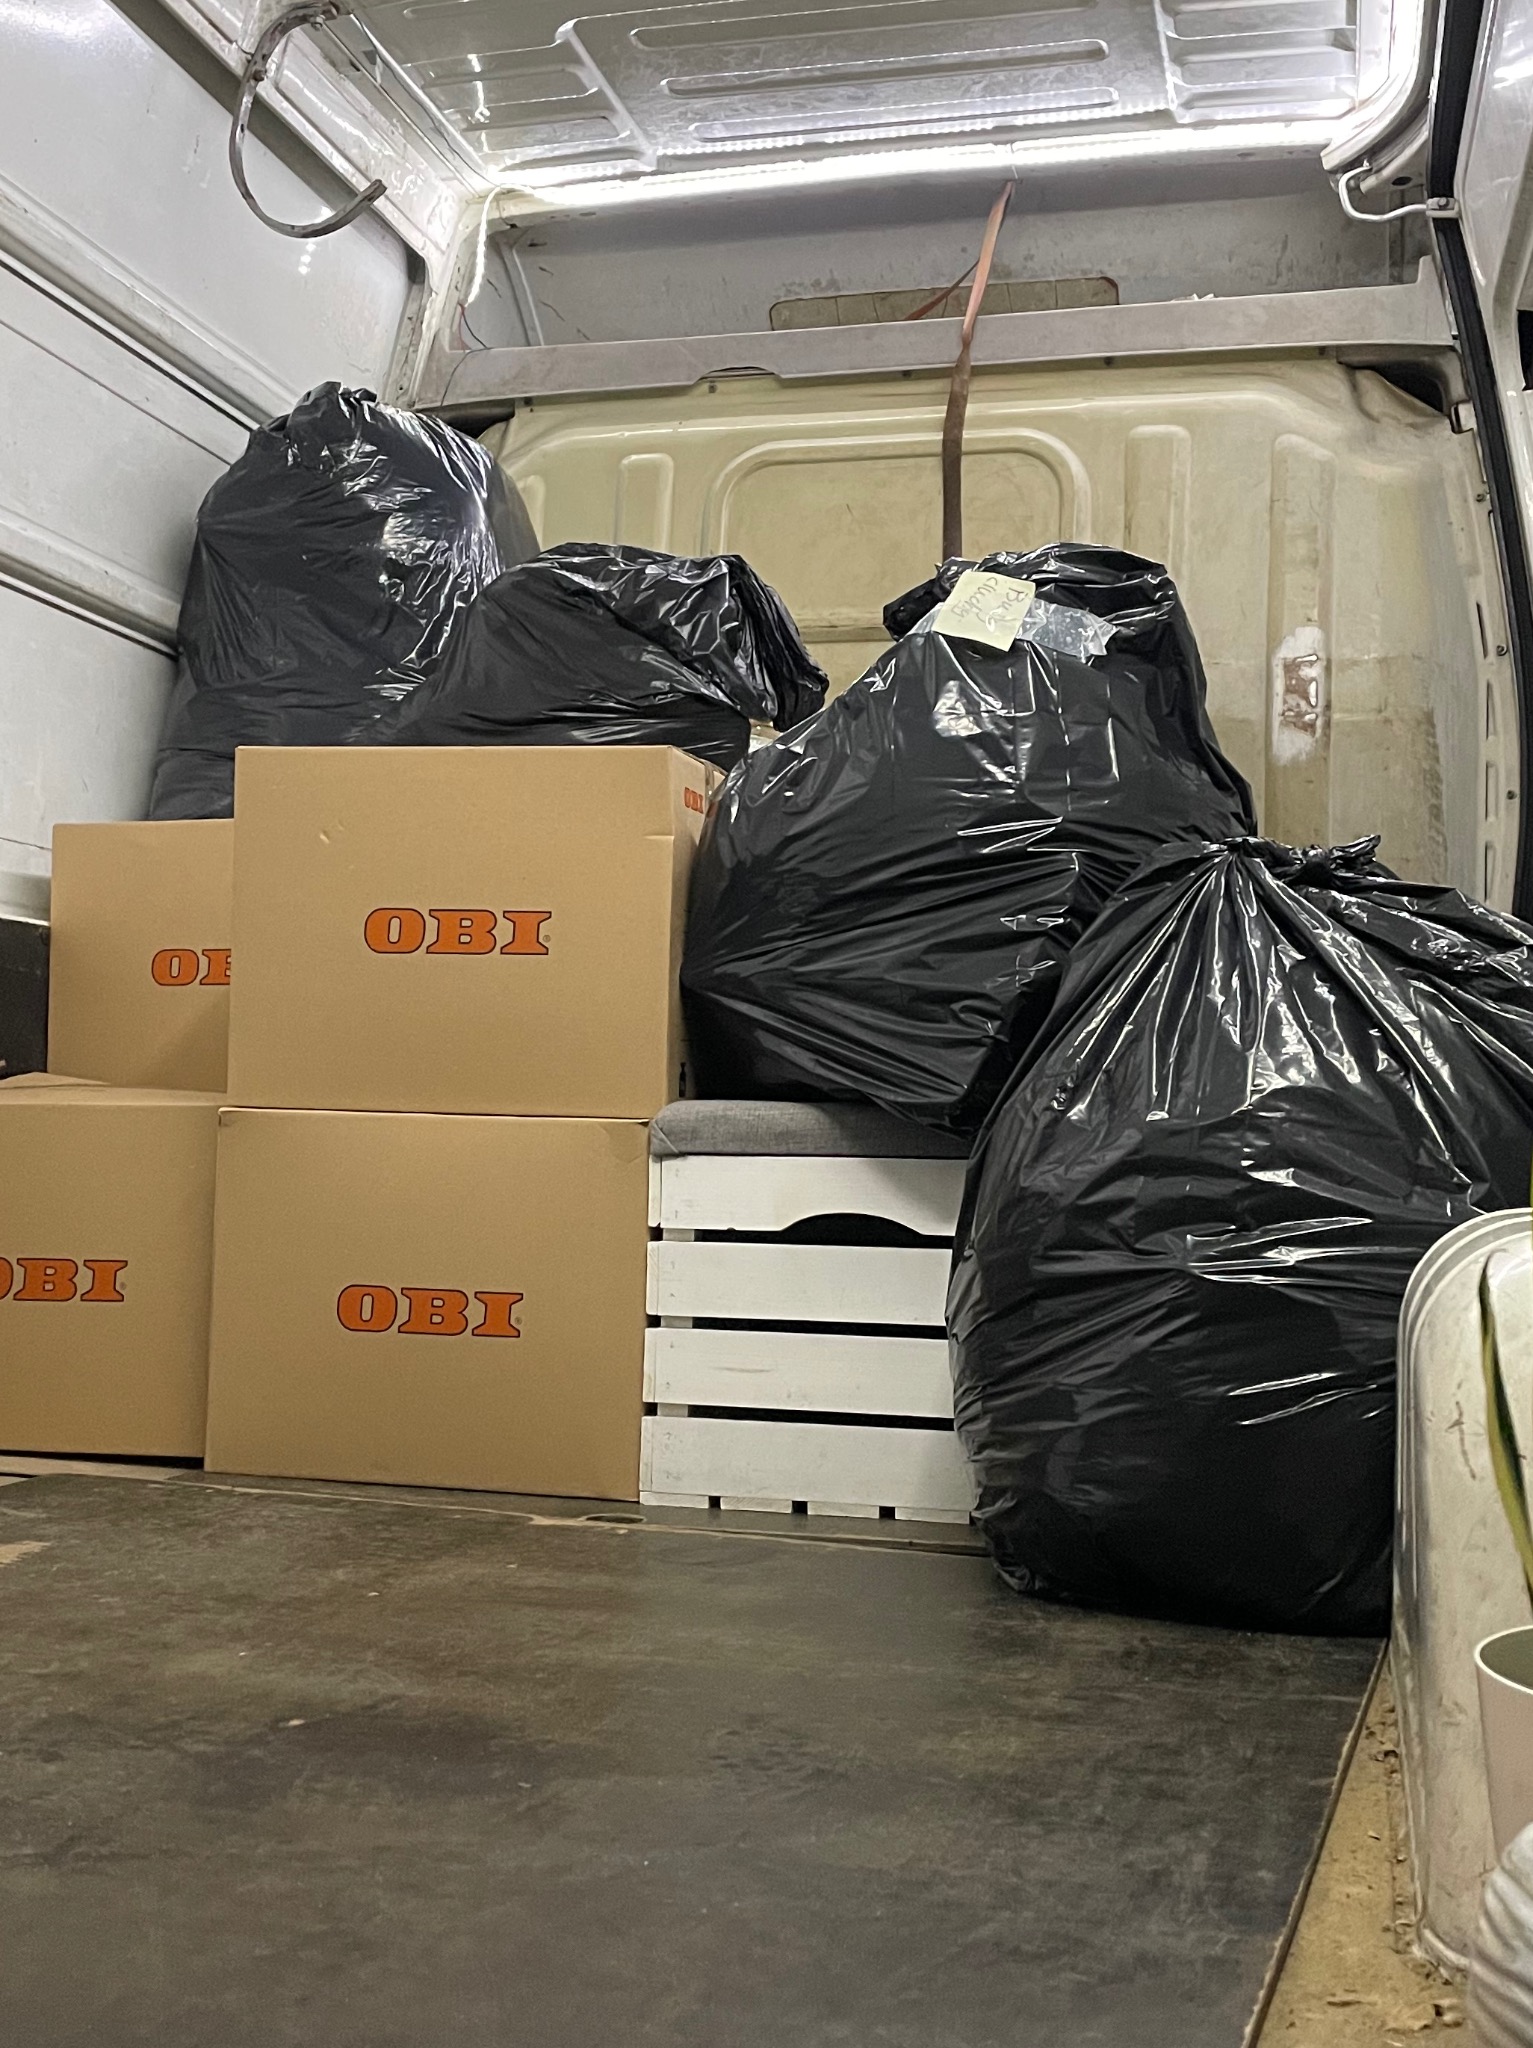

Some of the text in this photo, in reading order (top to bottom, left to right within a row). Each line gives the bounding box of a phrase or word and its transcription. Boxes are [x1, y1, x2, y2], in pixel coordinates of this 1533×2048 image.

[364, 907, 552, 956] OBI
[152, 949, 231, 986] OB
[0, 1257, 128, 1302] BI
[337, 1284, 524, 1338] OBI
